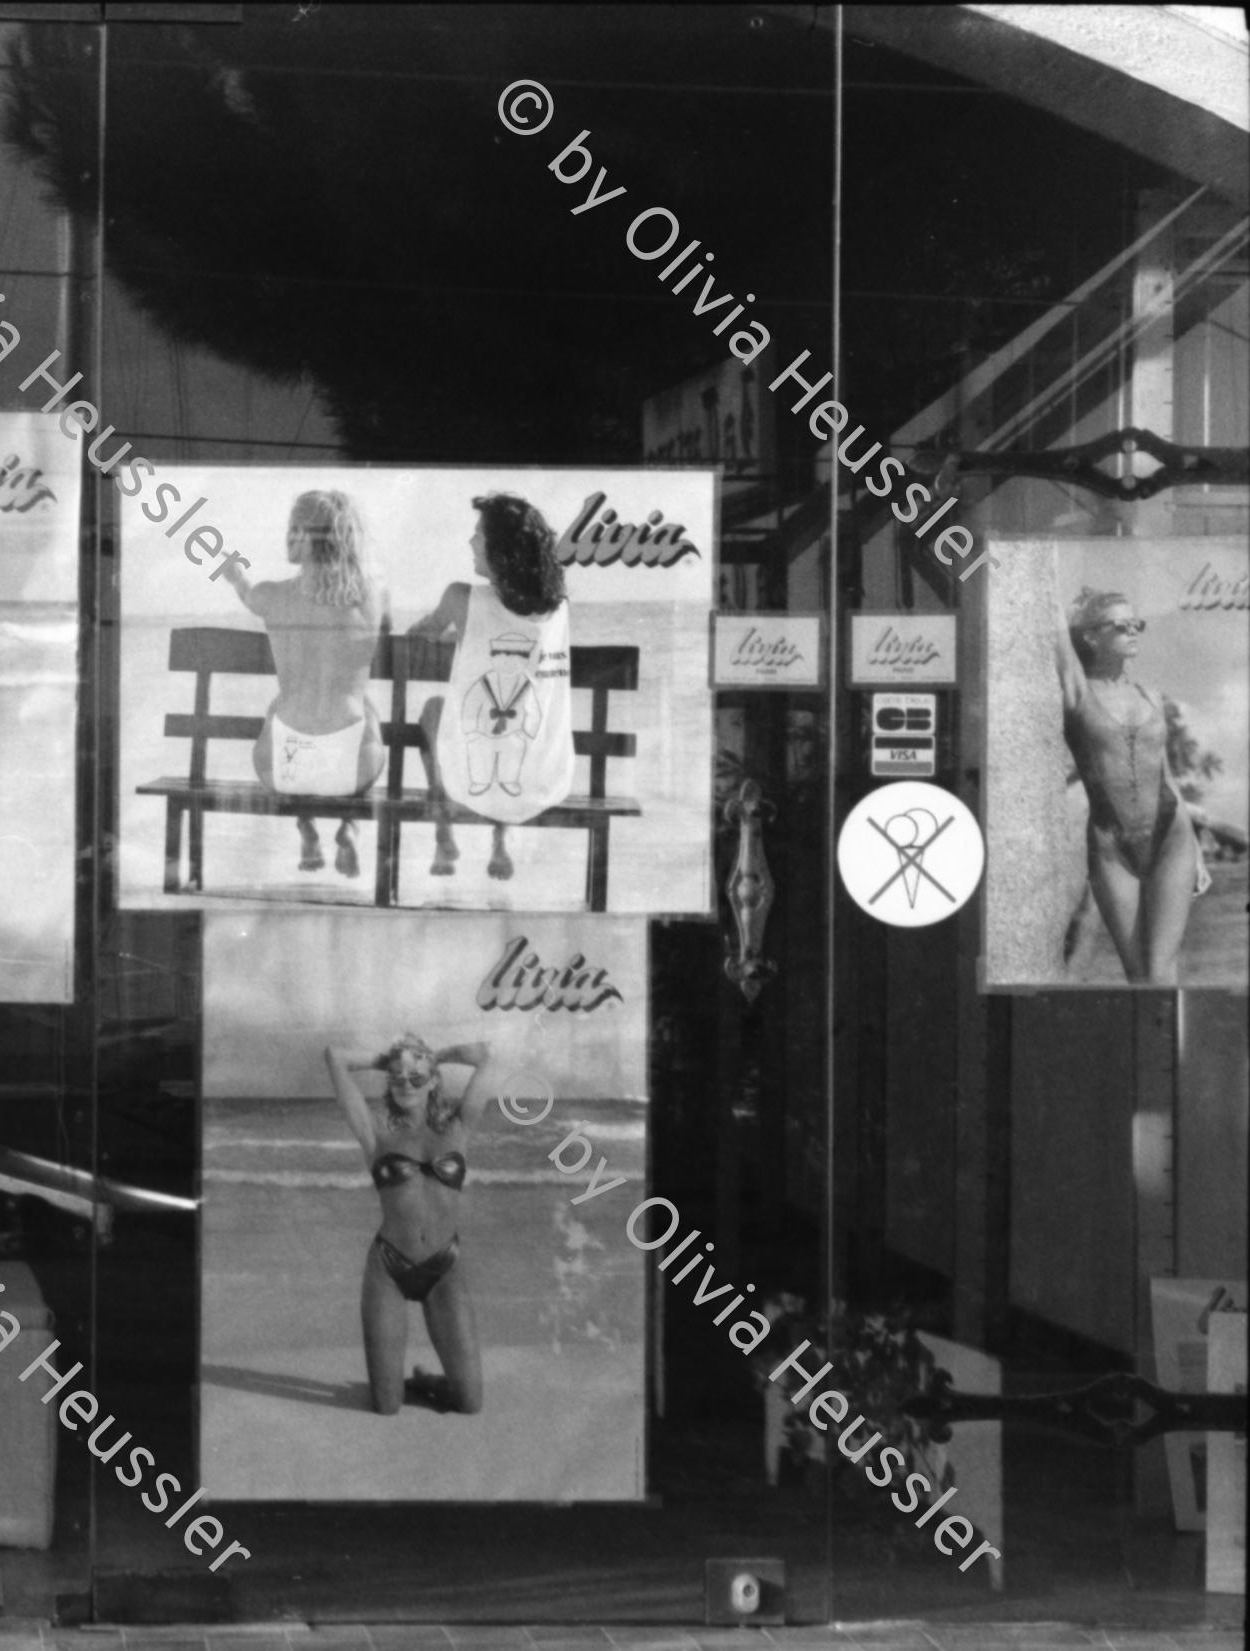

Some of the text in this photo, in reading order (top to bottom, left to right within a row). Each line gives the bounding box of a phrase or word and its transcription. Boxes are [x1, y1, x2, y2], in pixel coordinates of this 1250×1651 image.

[556, 491, 702, 568] livia
[730, 627, 804, 667] livia
[867, 626, 940, 665] livia
[890, 750, 917, 760] VISA
[476, 935, 624, 1012] livia
